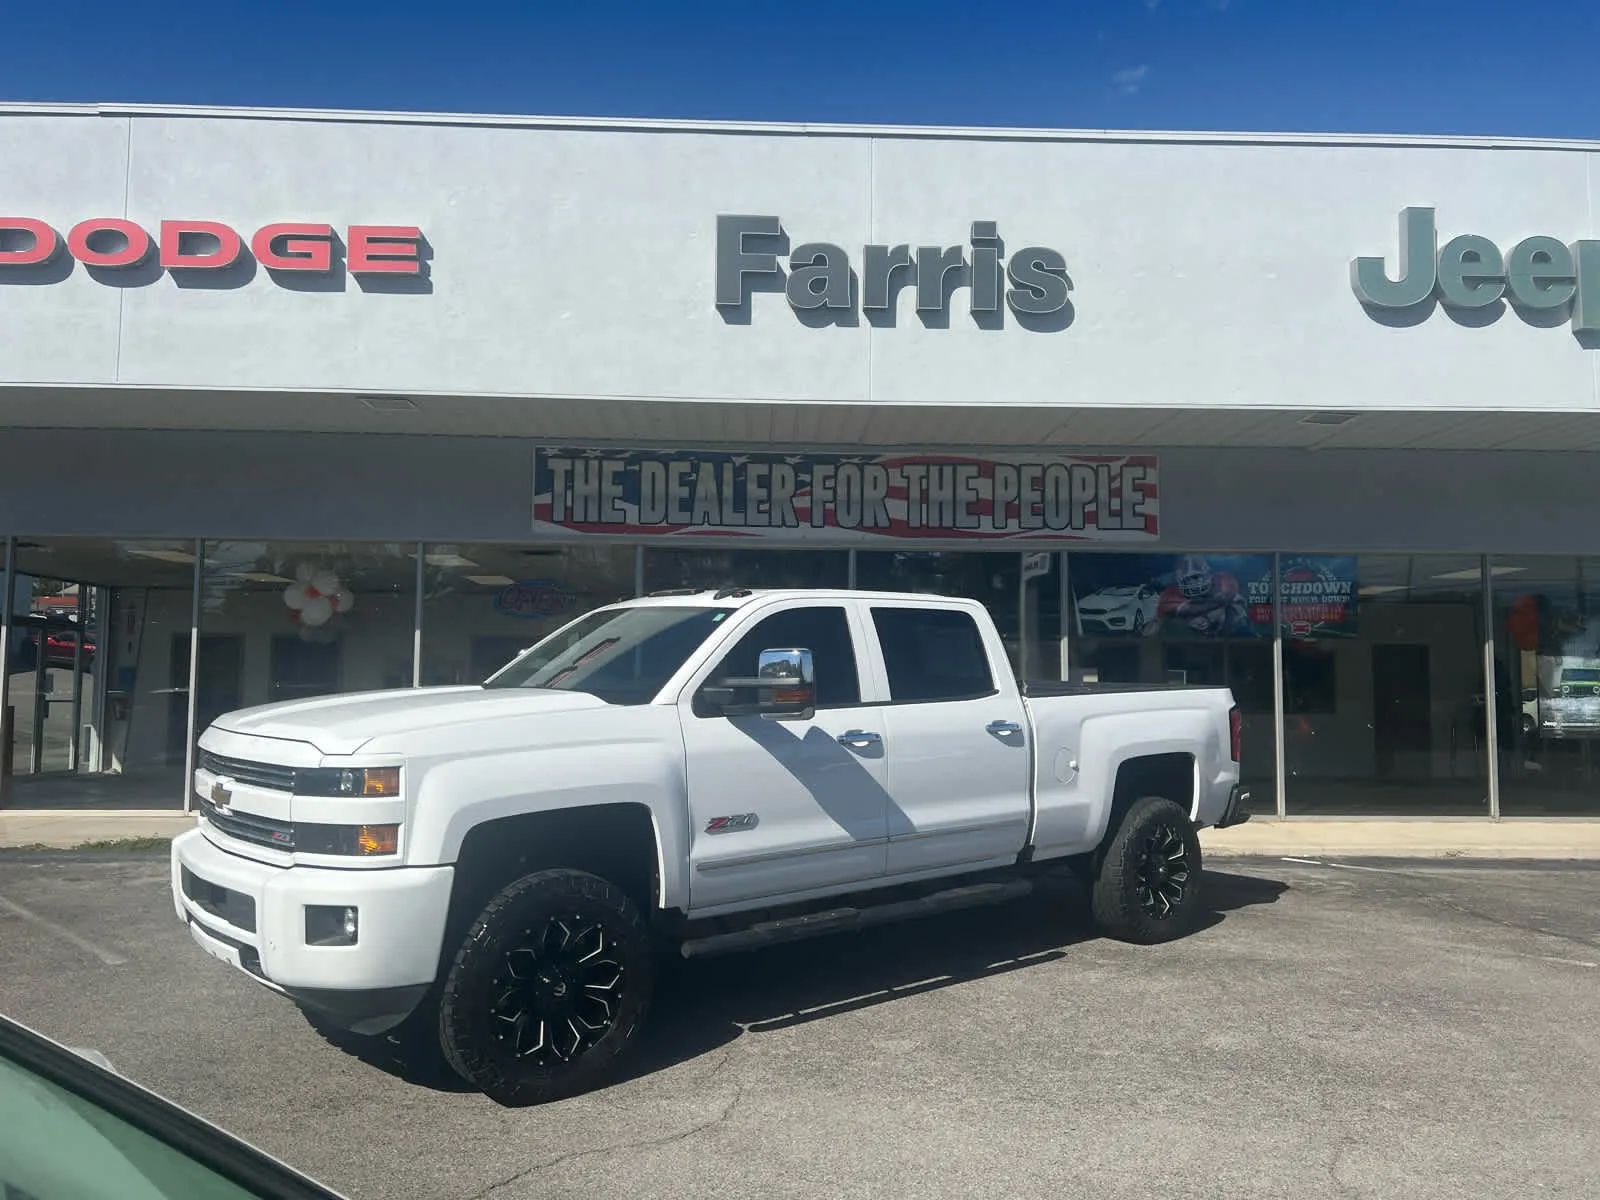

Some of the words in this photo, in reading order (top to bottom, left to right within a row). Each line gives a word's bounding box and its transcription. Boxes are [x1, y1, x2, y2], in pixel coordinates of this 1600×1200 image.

[0, 217, 421, 273] DODGE
[715, 215, 1069, 314] Farris
[547, 457, 627, 524] THE
[639, 459, 800, 527] DEALER
[811, 462, 891, 529] FOR
[901, 463, 981, 529] THE
[993, 463, 1147, 531] PEOPLE
[1247, 582, 1352, 595] TOCHDOWN
